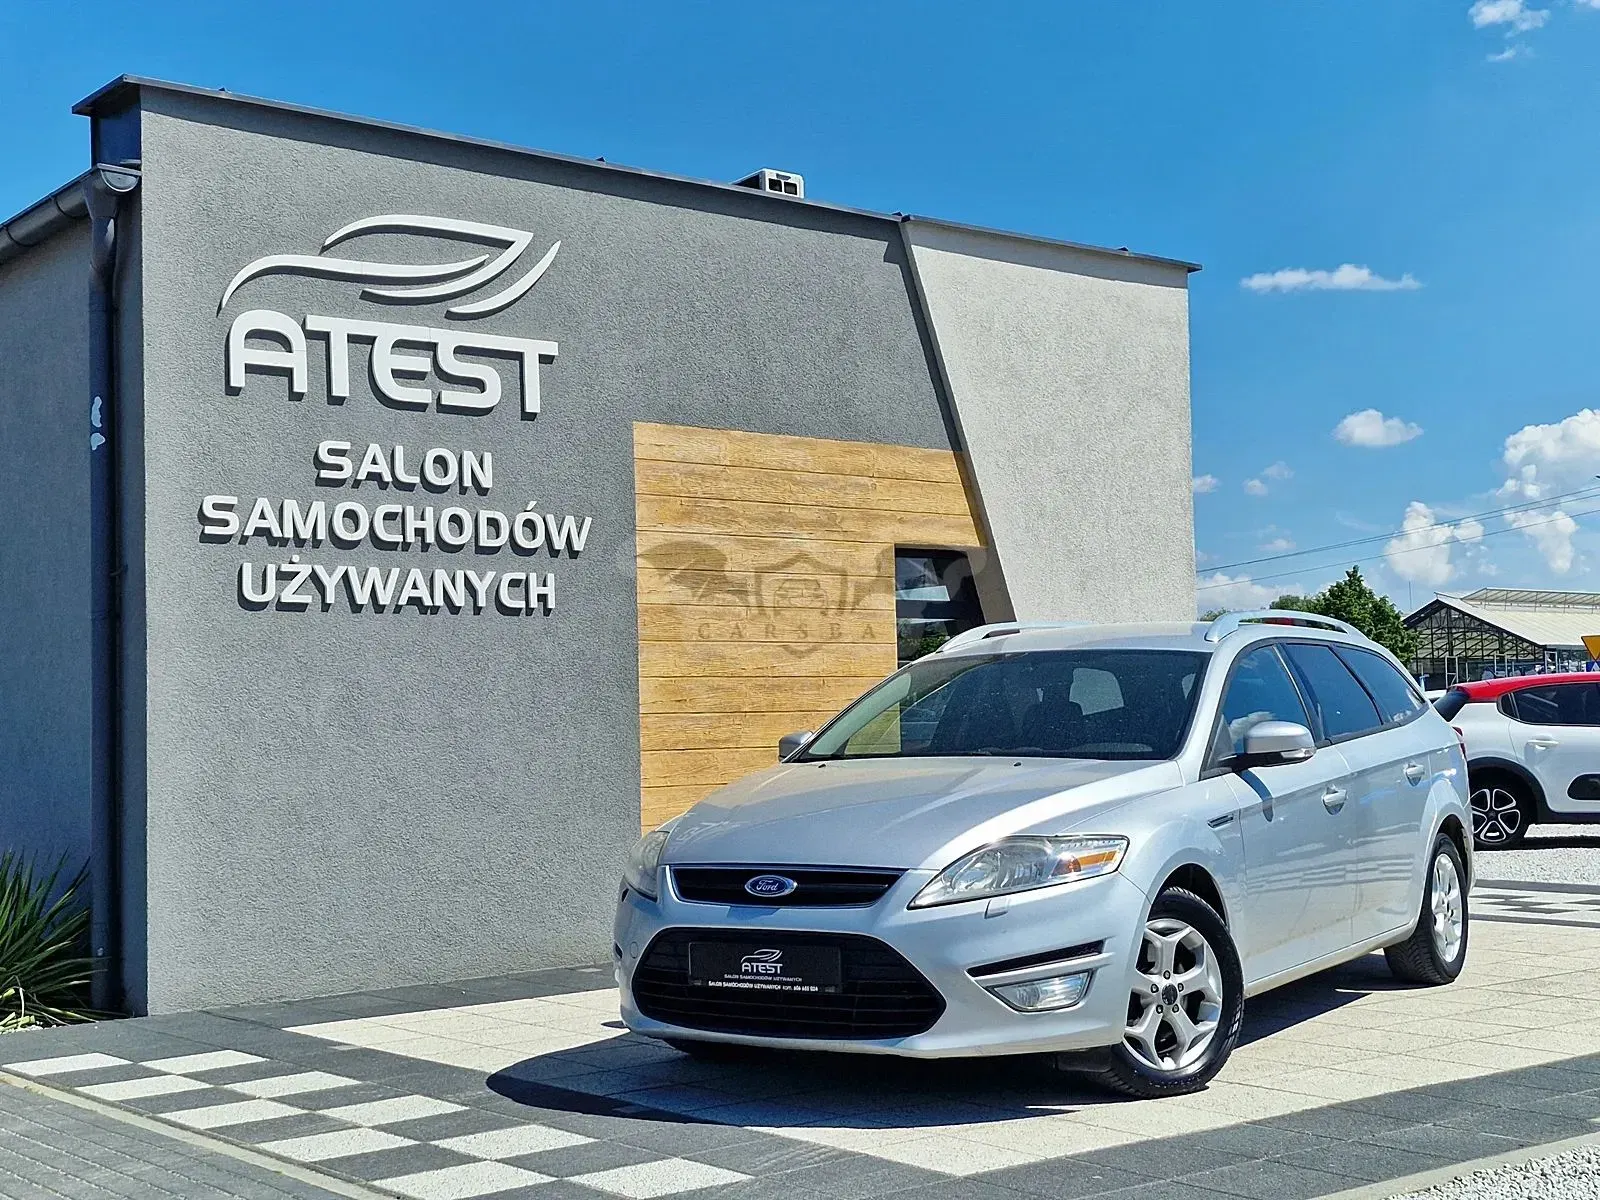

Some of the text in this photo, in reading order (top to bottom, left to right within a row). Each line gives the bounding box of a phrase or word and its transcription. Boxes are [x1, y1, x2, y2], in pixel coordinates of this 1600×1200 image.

[228, 309, 559, 415] ATEST
[317, 440, 493, 490] SALON
[201, 495, 593, 552] SAMOCHODÓW
[241, 555, 556, 610] UŻYWANYCH
[756, 879, 779, 891] Ford
[741, 962, 783, 975] ATEST
